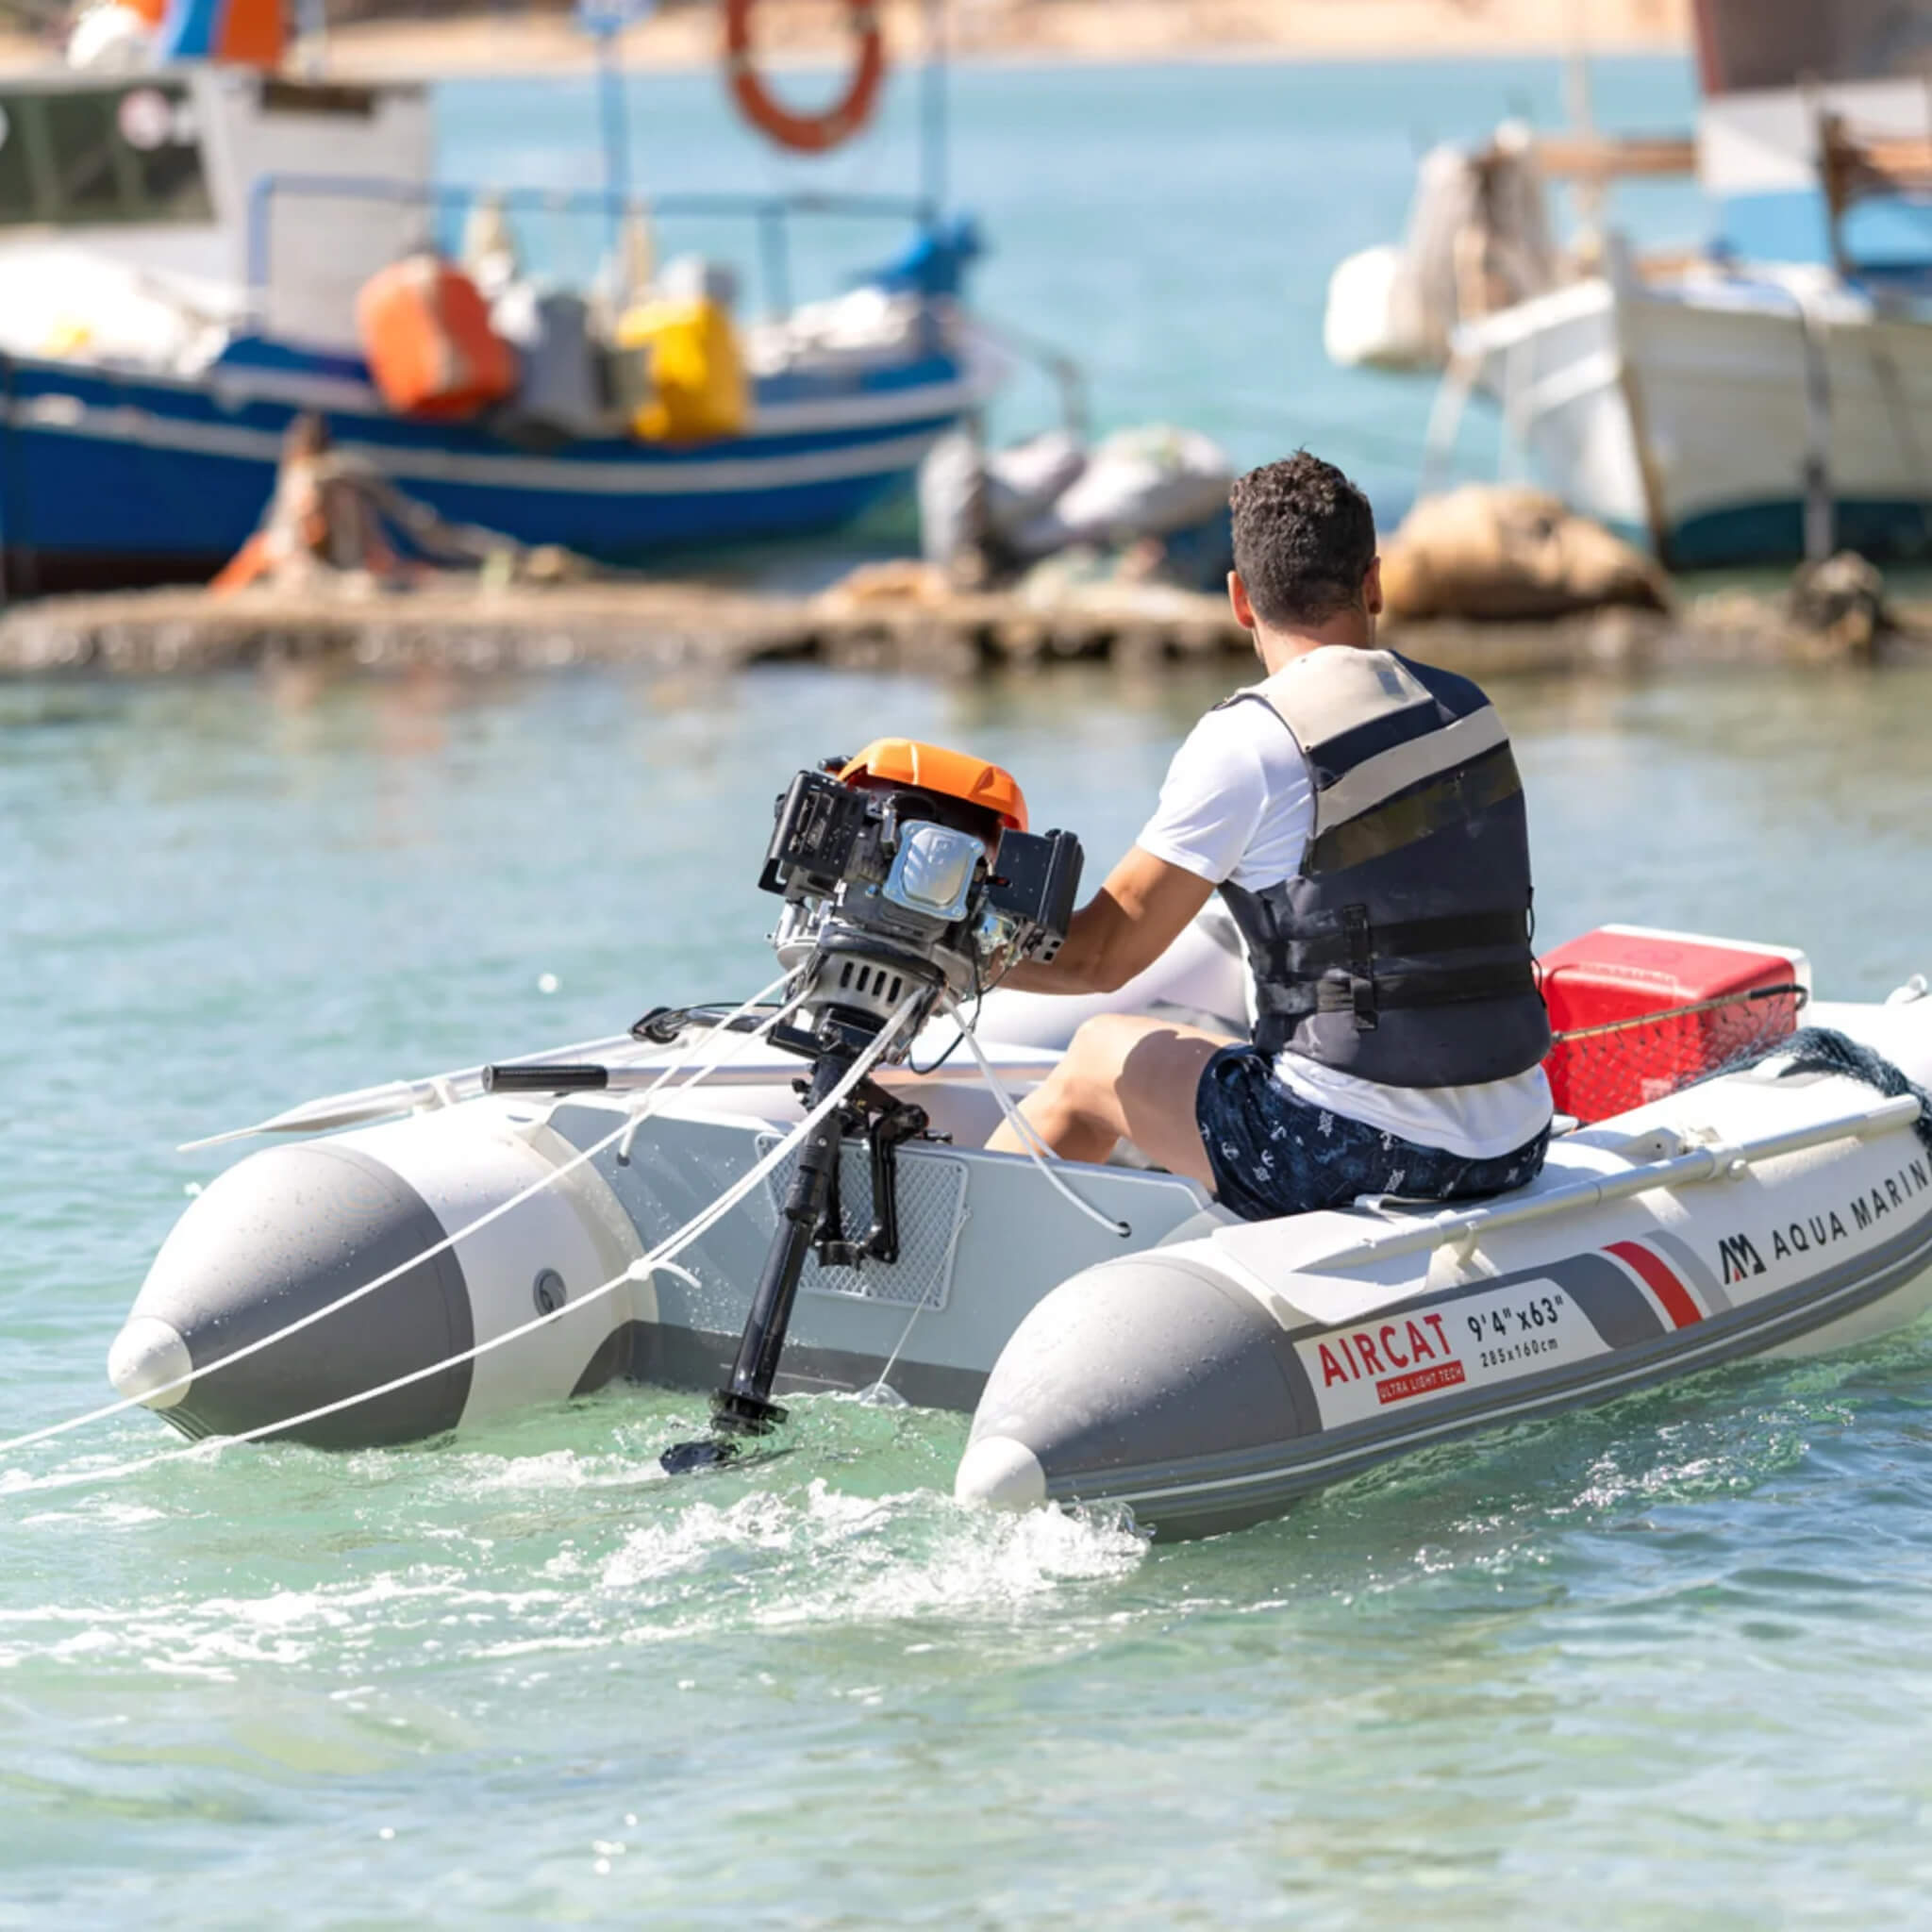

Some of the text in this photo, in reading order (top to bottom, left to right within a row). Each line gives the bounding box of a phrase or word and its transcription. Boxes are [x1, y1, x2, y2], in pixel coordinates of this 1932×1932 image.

[1772, 1211, 1848, 1260] AQUA
[1850, 1151, 1932, 1230] MARIN
[1318, 1312, 1452, 1388] AIRCAT
[1479, 1338, 1558, 1368] 285x160cm
[1379, 1365, 1462, 1399] ULTRA LIGHT TECH
